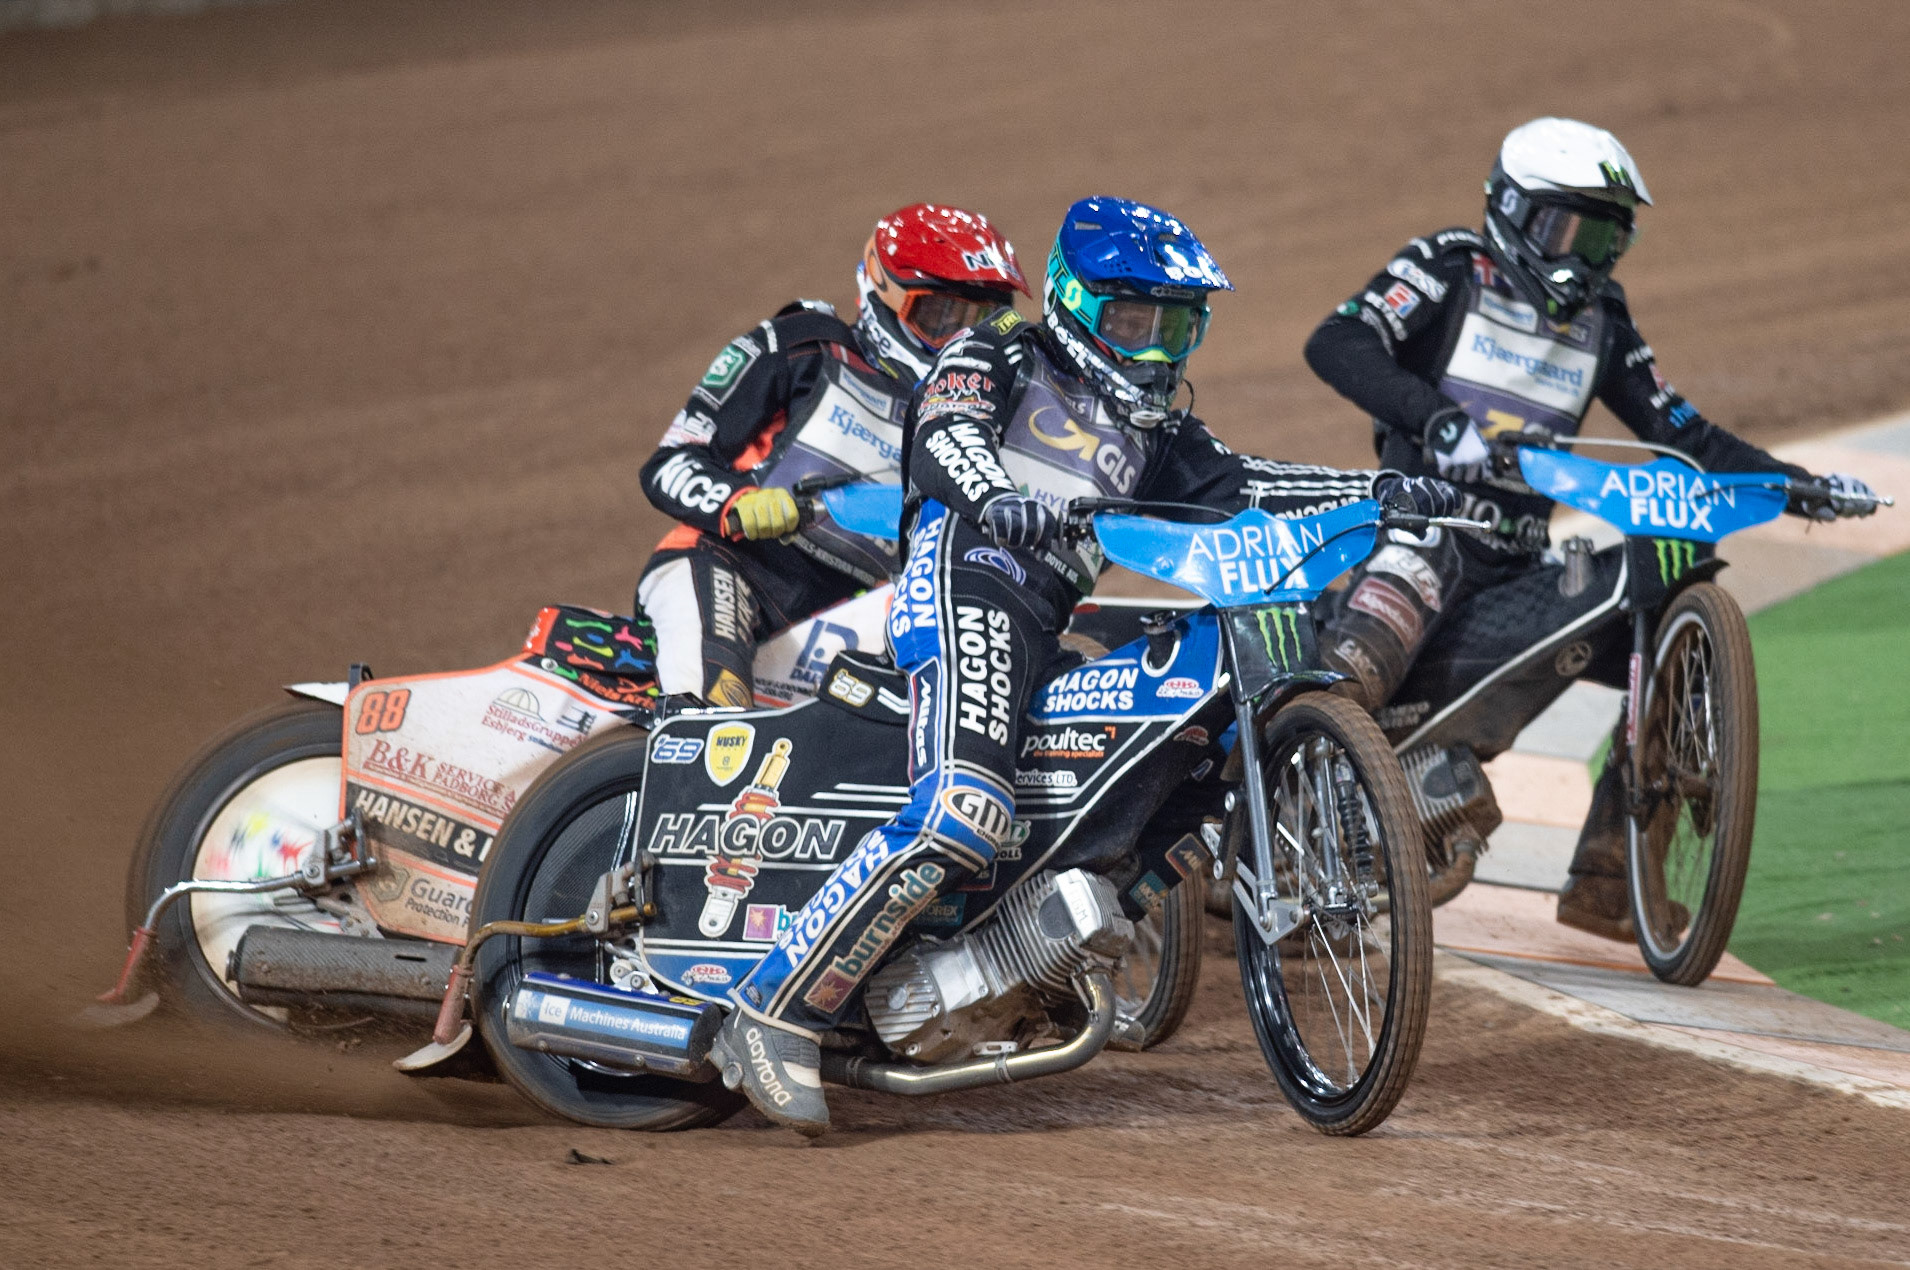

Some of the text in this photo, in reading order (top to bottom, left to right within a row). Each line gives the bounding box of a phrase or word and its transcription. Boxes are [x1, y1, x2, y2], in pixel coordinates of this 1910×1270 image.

[828, 404, 902, 462] Kjærga
[948, 422, 1016, 491] HAGON
[652, 452, 731, 513] Nice
[925, 430, 989, 502] SHOCKS
[1096, 444, 1136, 494] GLS
[1602, 469, 1736, 509] ADRIAN
[1631, 498, 1714, 533] FLUX
[1186, 523, 1325, 566] ADRIAN
[909, 517, 943, 628] HAGON
[1219, 556, 1311, 595] FLUX
[713, 566, 736, 642] HANSEN
[957, 605, 988, 735] HAGON
[987, 609, 1012, 746] SHOCKS
[1048, 667, 1139, 693] HAGON
[355, 689, 411, 735] 88
[1043, 690, 1134, 713] SHOCKS
[482, 715, 527, 742] Esbjerg
[716, 736, 747, 747] HUSKY
[1020, 727, 1107, 758] poultec
[366, 739, 506, 794] B&K SERVICE
[433, 772, 499, 806] PADBORG
[1016, 771, 1053, 784] ervices
[356, 790, 455, 848] HANSEN
[453, 828, 477, 858] &
[649, 812, 847, 860] HAGON
[405, 899, 460, 926] Protection
[785, 841, 889, 968] HAGON
[835, 863, 944, 976] burnside
[544, 1003, 688, 1041] Ice Machines Australia
[745, 1027, 792, 1108] daytona
